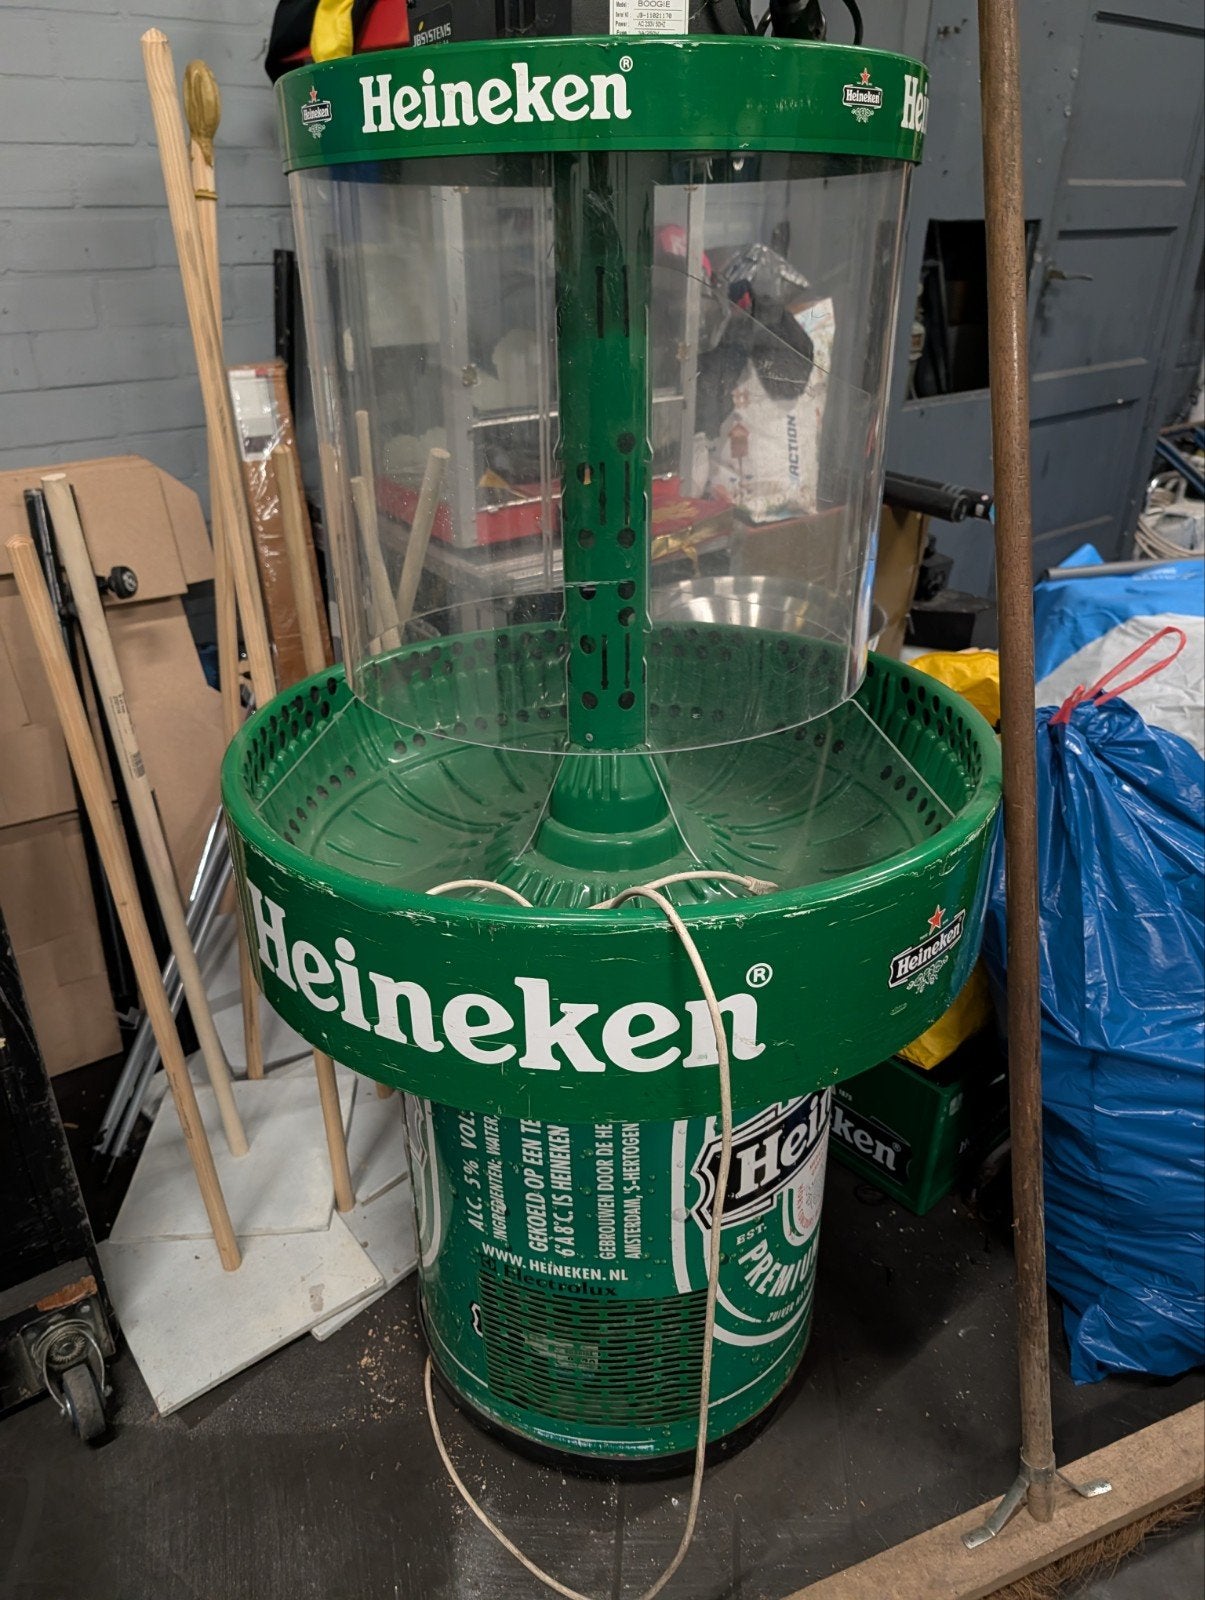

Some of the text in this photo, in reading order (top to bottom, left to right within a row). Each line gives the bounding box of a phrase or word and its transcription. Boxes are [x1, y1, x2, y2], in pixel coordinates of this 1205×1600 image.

[637, 0, 671, 8] BOOGIE
[786, 414, 800, 478] ACTION
[521, 1138, 544, 1166] EEN
[547, 1124, 573, 1191] HEINEKEN
[594, 1141, 614, 1156] DE
[463, 1159, 482, 1190] 5%
[523, 1168, 546, 1190] OP
[595, 1159, 615, 1191] DOOR
[466, 1197, 486, 1233] ALC.
[551, 1194, 574, 1208] IS
[525, 1192, 550, 1253] GEKOELD
[597, 1194, 617, 1260] GEBROUWEN
[736, 1222, 767, 1246] EST.
[503, 1263, 618, 1297] Electrolux
